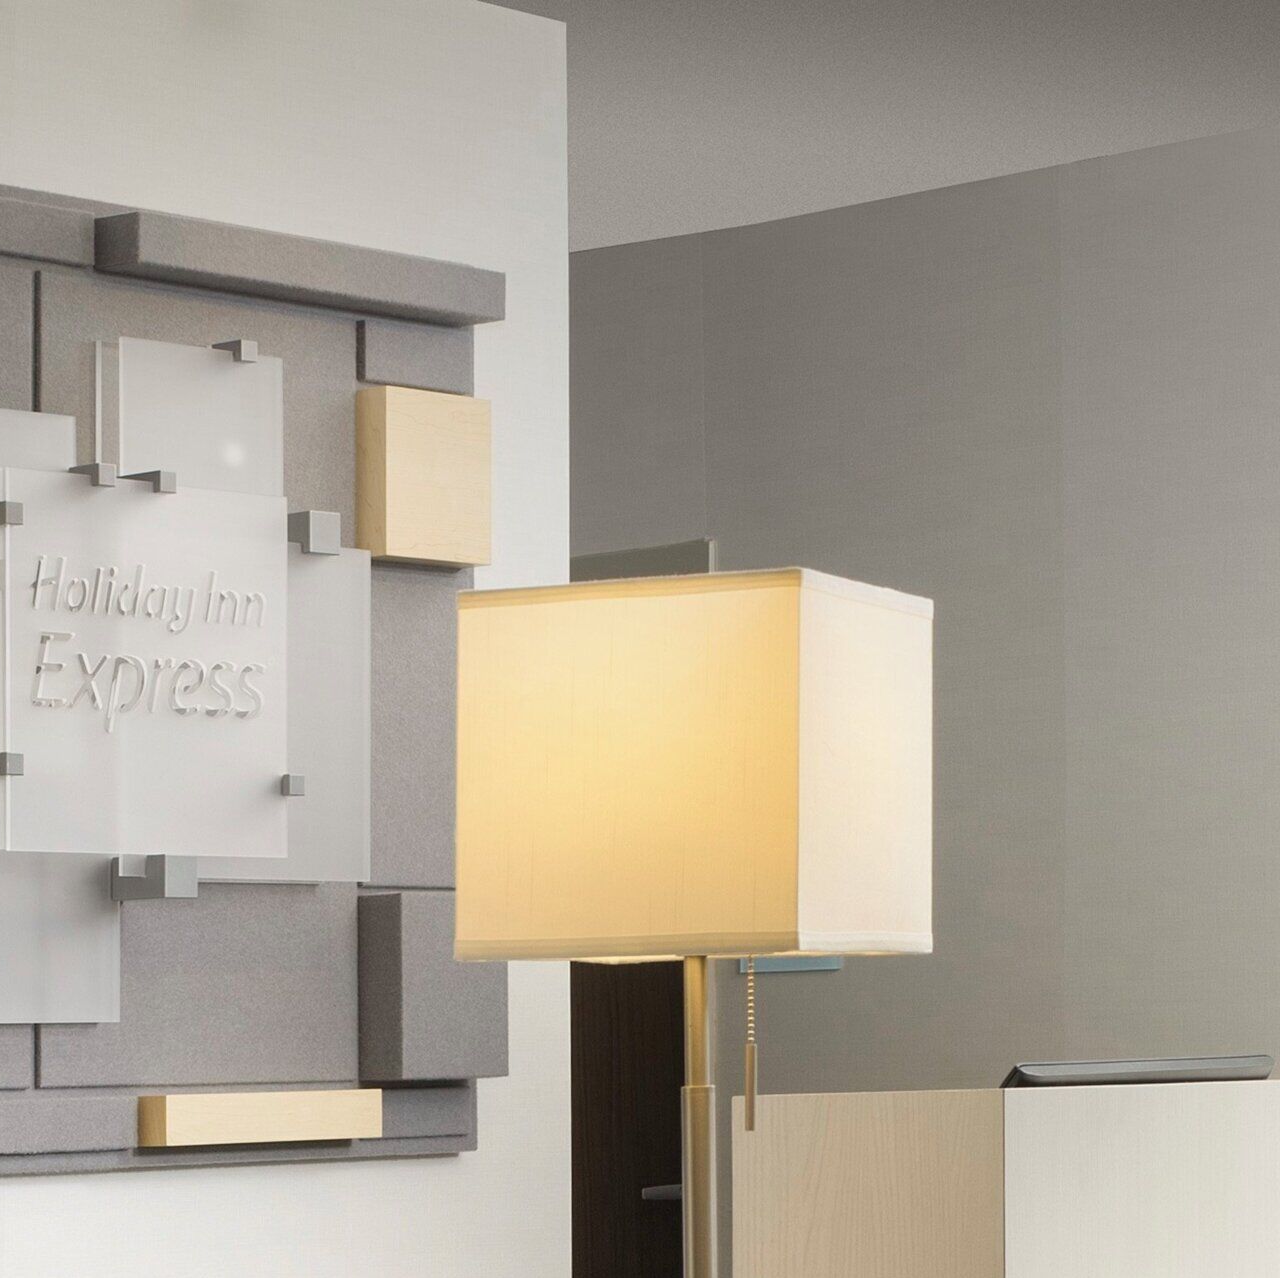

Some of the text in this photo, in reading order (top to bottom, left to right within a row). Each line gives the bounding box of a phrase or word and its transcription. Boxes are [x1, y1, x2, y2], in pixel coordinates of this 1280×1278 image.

[30, 554, 268, 635] Holiday Inn
[32, 630, 267, 734] Express
